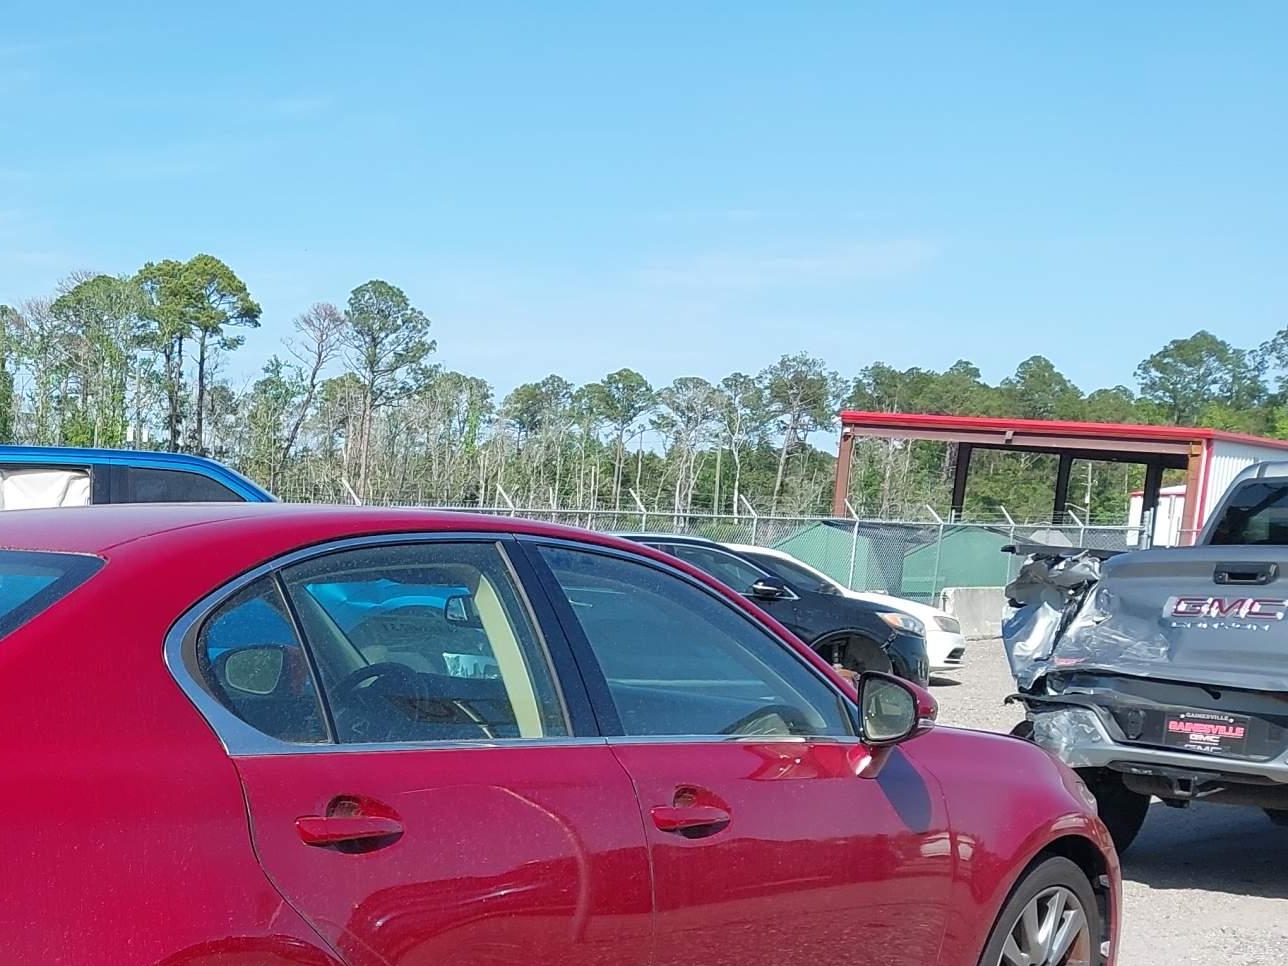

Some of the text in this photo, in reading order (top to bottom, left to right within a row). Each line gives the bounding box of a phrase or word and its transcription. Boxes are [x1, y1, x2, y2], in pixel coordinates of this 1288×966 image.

[1170, 597, 1288, 619] GMC
[1186, 711, 1229, 721] GAINESVILLE
[1168, 720, 1245, 737] GAINESVILLE
[1189, 733, 1221, 743] GMC
